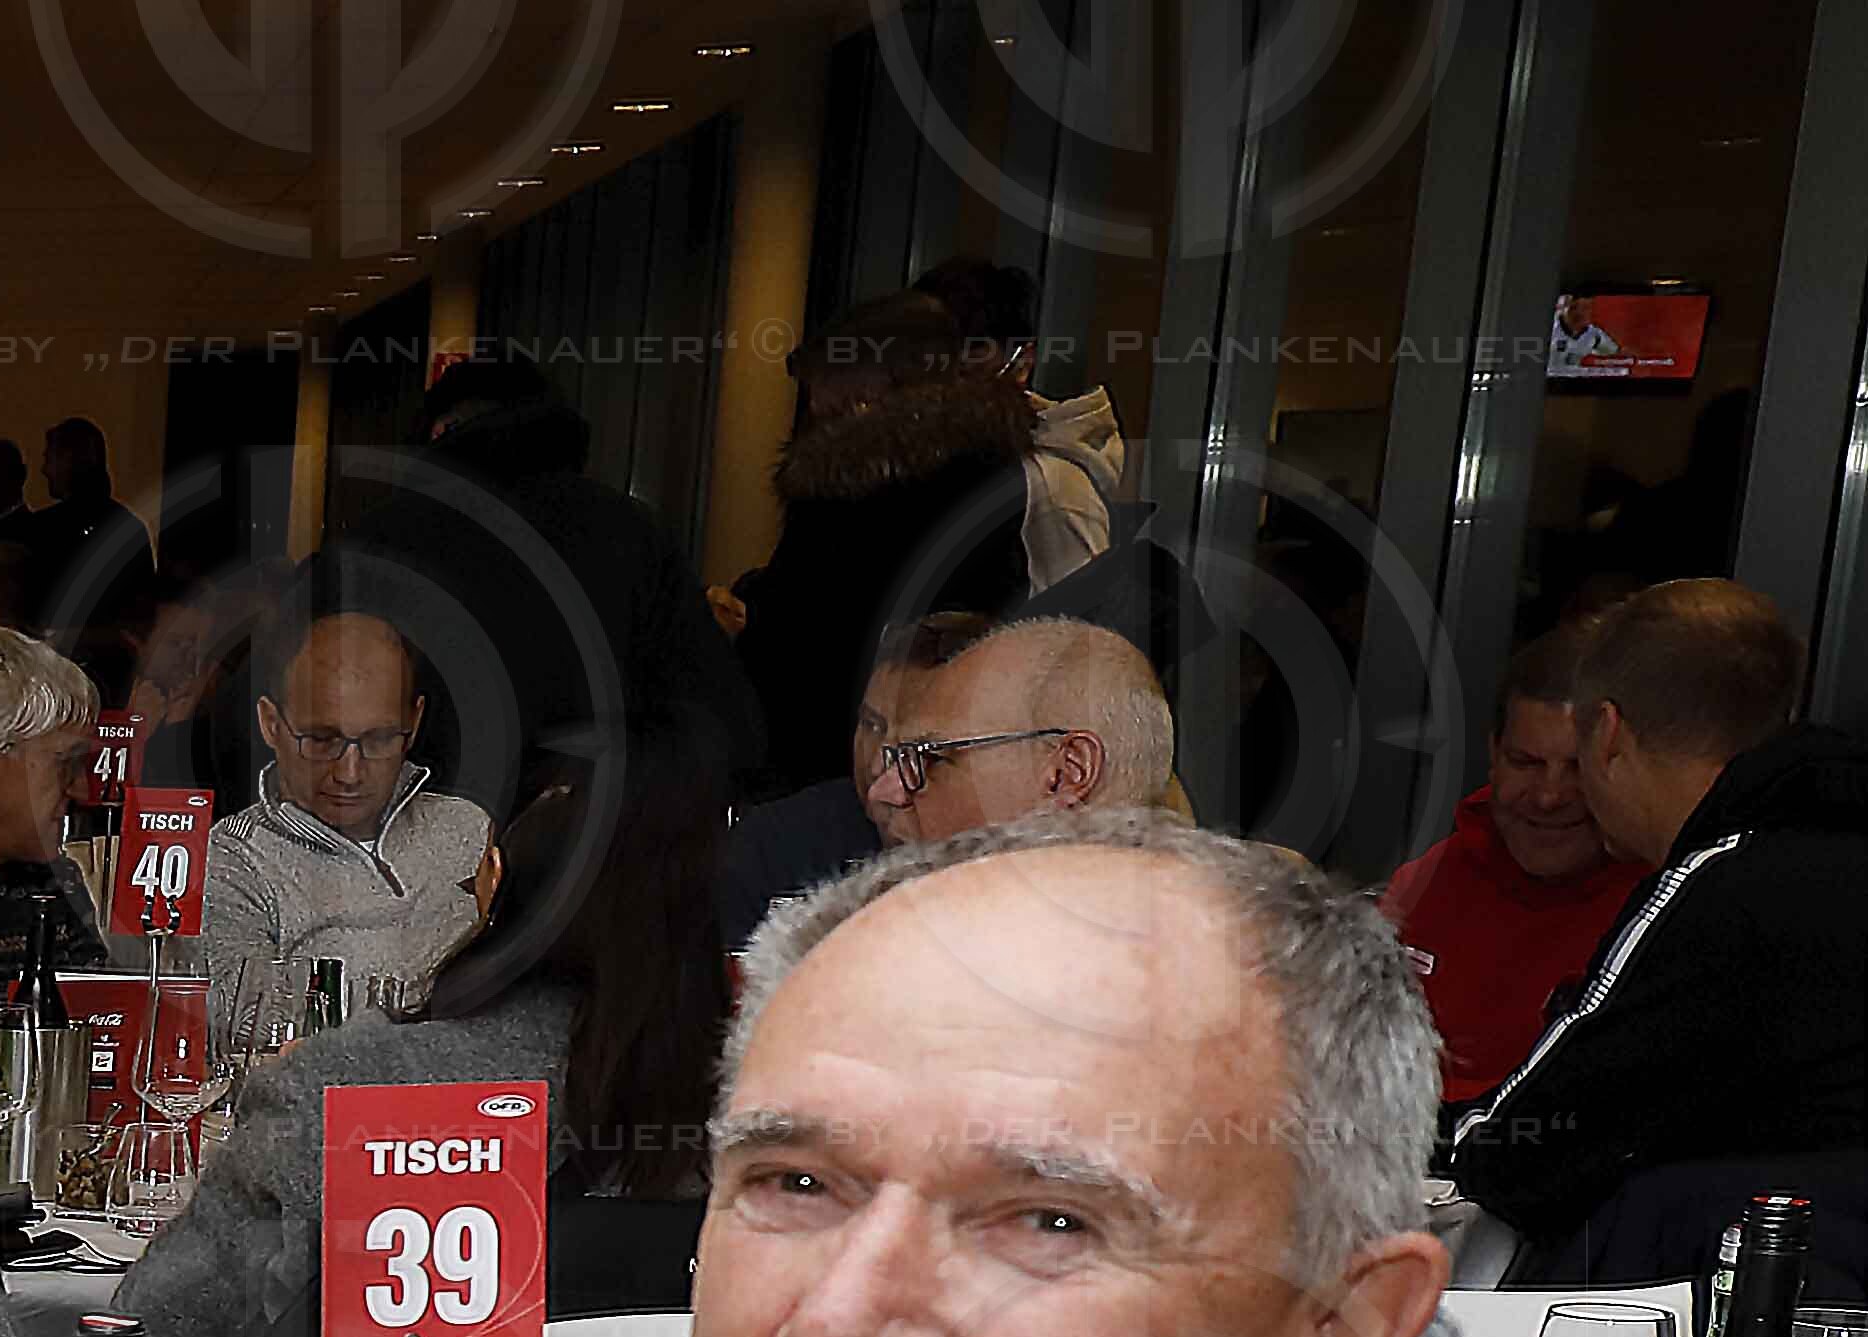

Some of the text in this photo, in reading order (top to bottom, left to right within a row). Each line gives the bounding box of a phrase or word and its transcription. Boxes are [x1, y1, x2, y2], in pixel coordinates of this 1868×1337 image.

[98, 726, 134, 738] TISCH
[94, 747, 128, 782] 41
[139, 813, 194, 831] TISCH
[131, 845, 189, 899] 40
[364, 1138, 501, 1176] TISCH
[365, 1207, 499, 1327] 39
